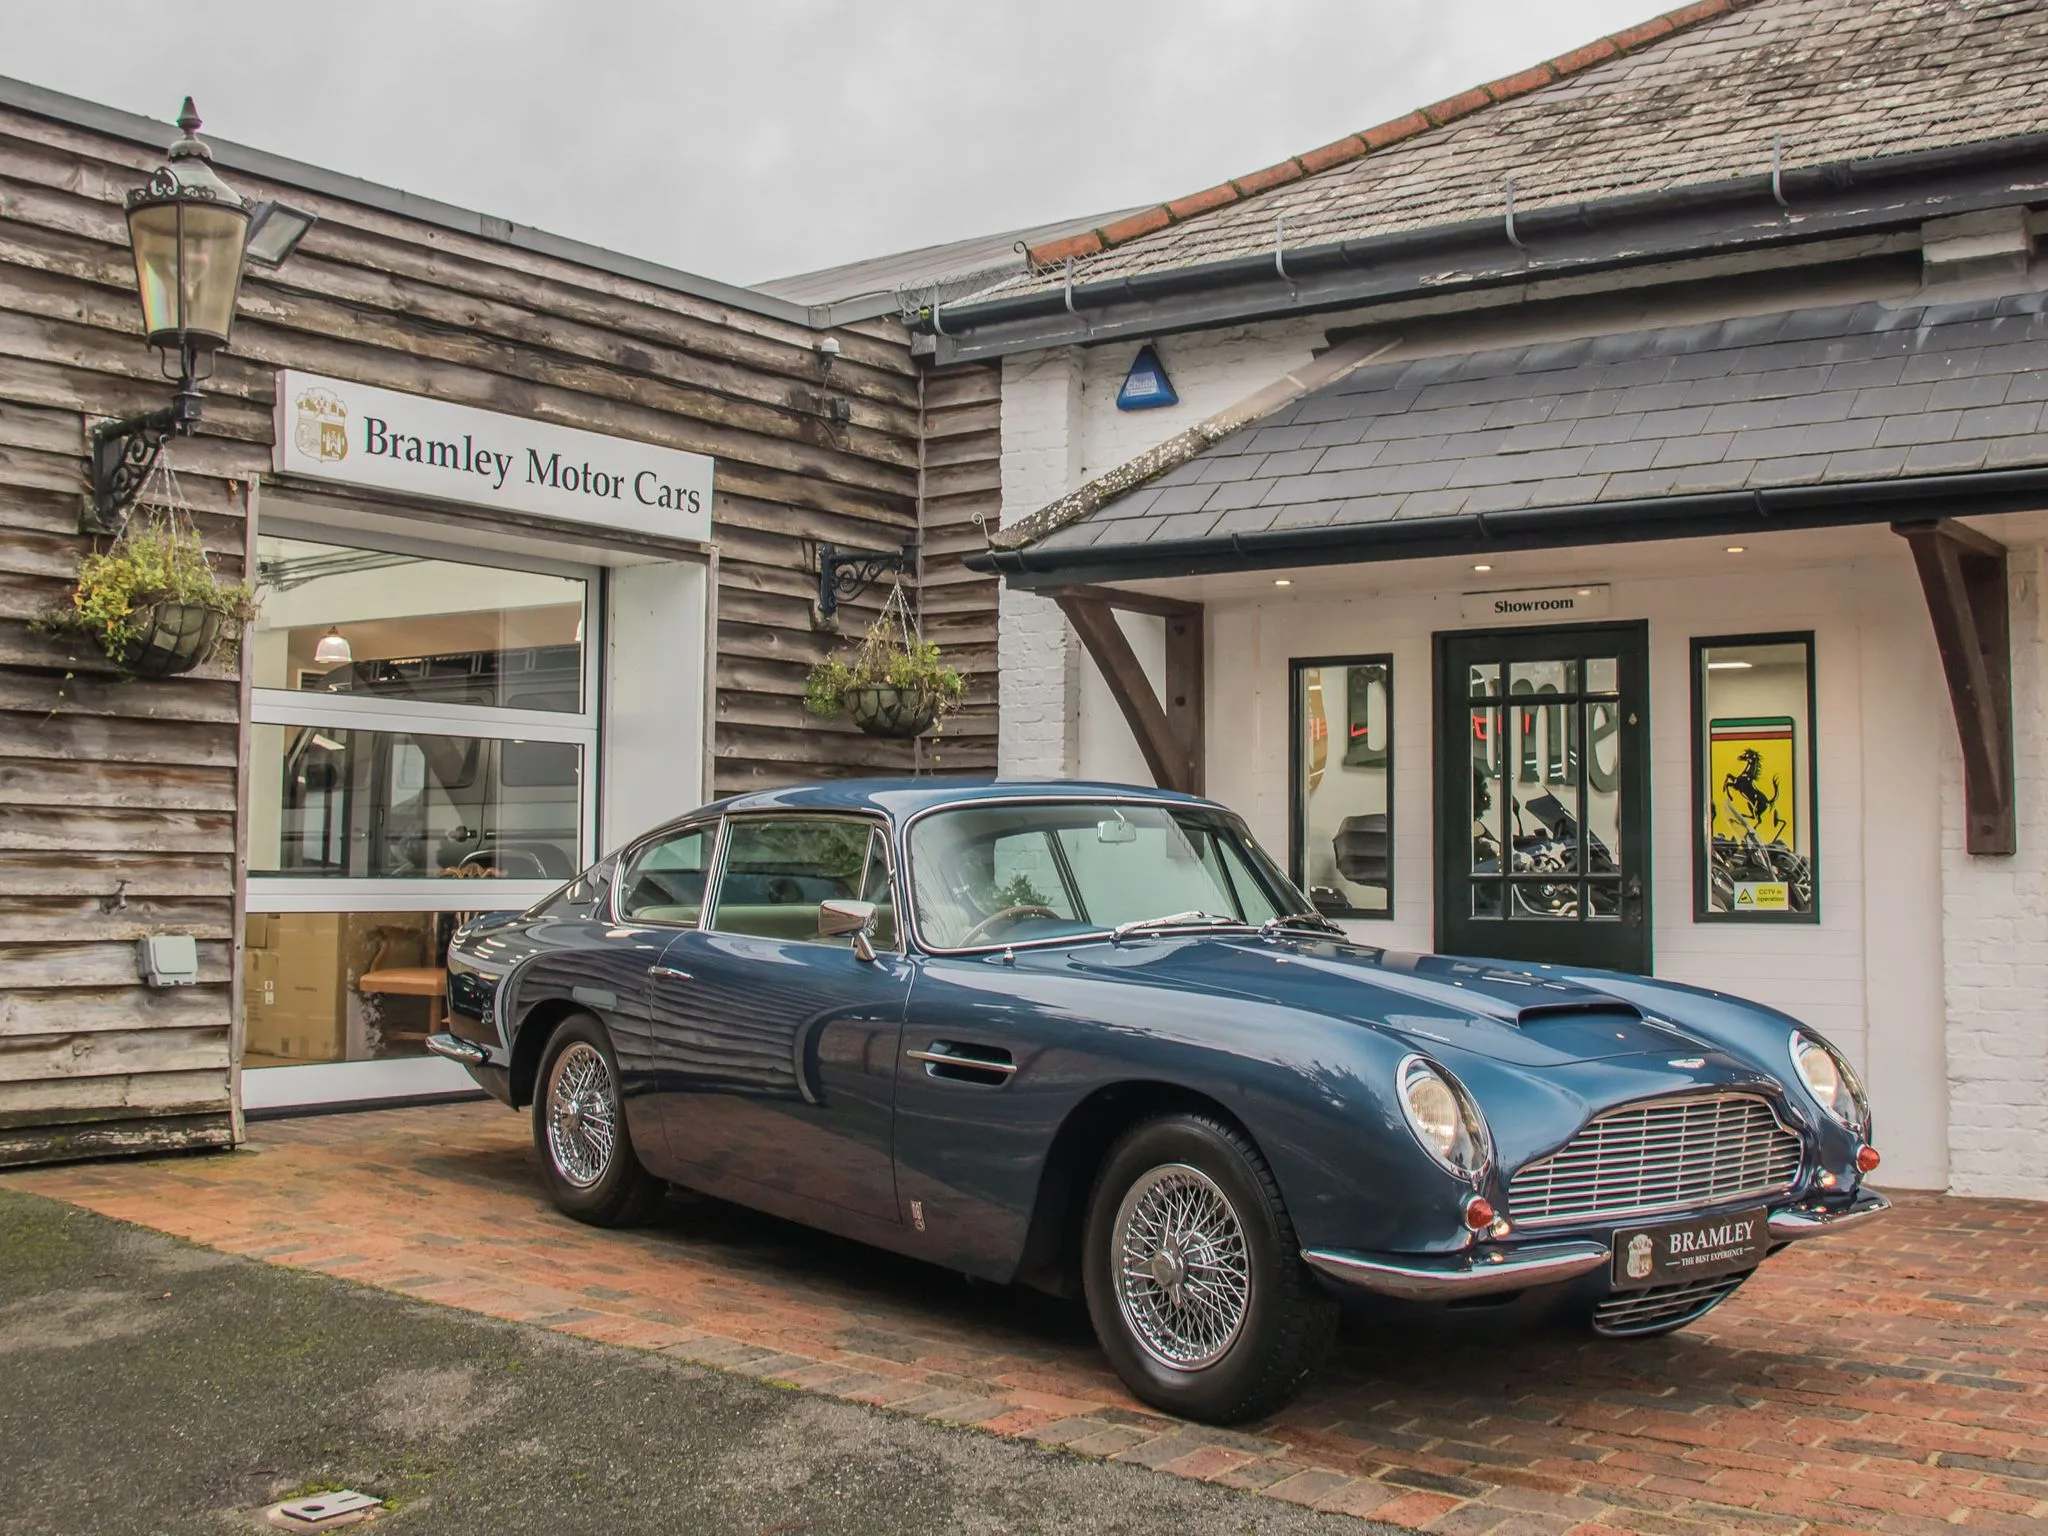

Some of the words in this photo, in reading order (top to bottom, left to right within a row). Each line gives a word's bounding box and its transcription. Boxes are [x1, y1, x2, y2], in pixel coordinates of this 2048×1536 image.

[363, 416, 513, 489] Bramley
[526, 448, 625, 499] Motor
[634, 471, 701, 513] Cars
[1494, 598, 1574, 613] Showroom
[1670, 1220, 1754, 1254] BRAMLEY
[1681, 1257, 1695, 1266] THE
[1695, 1253, 1710, 1264] BEST
[1710, 1248, 1743, 1261] EXPERIENCE
